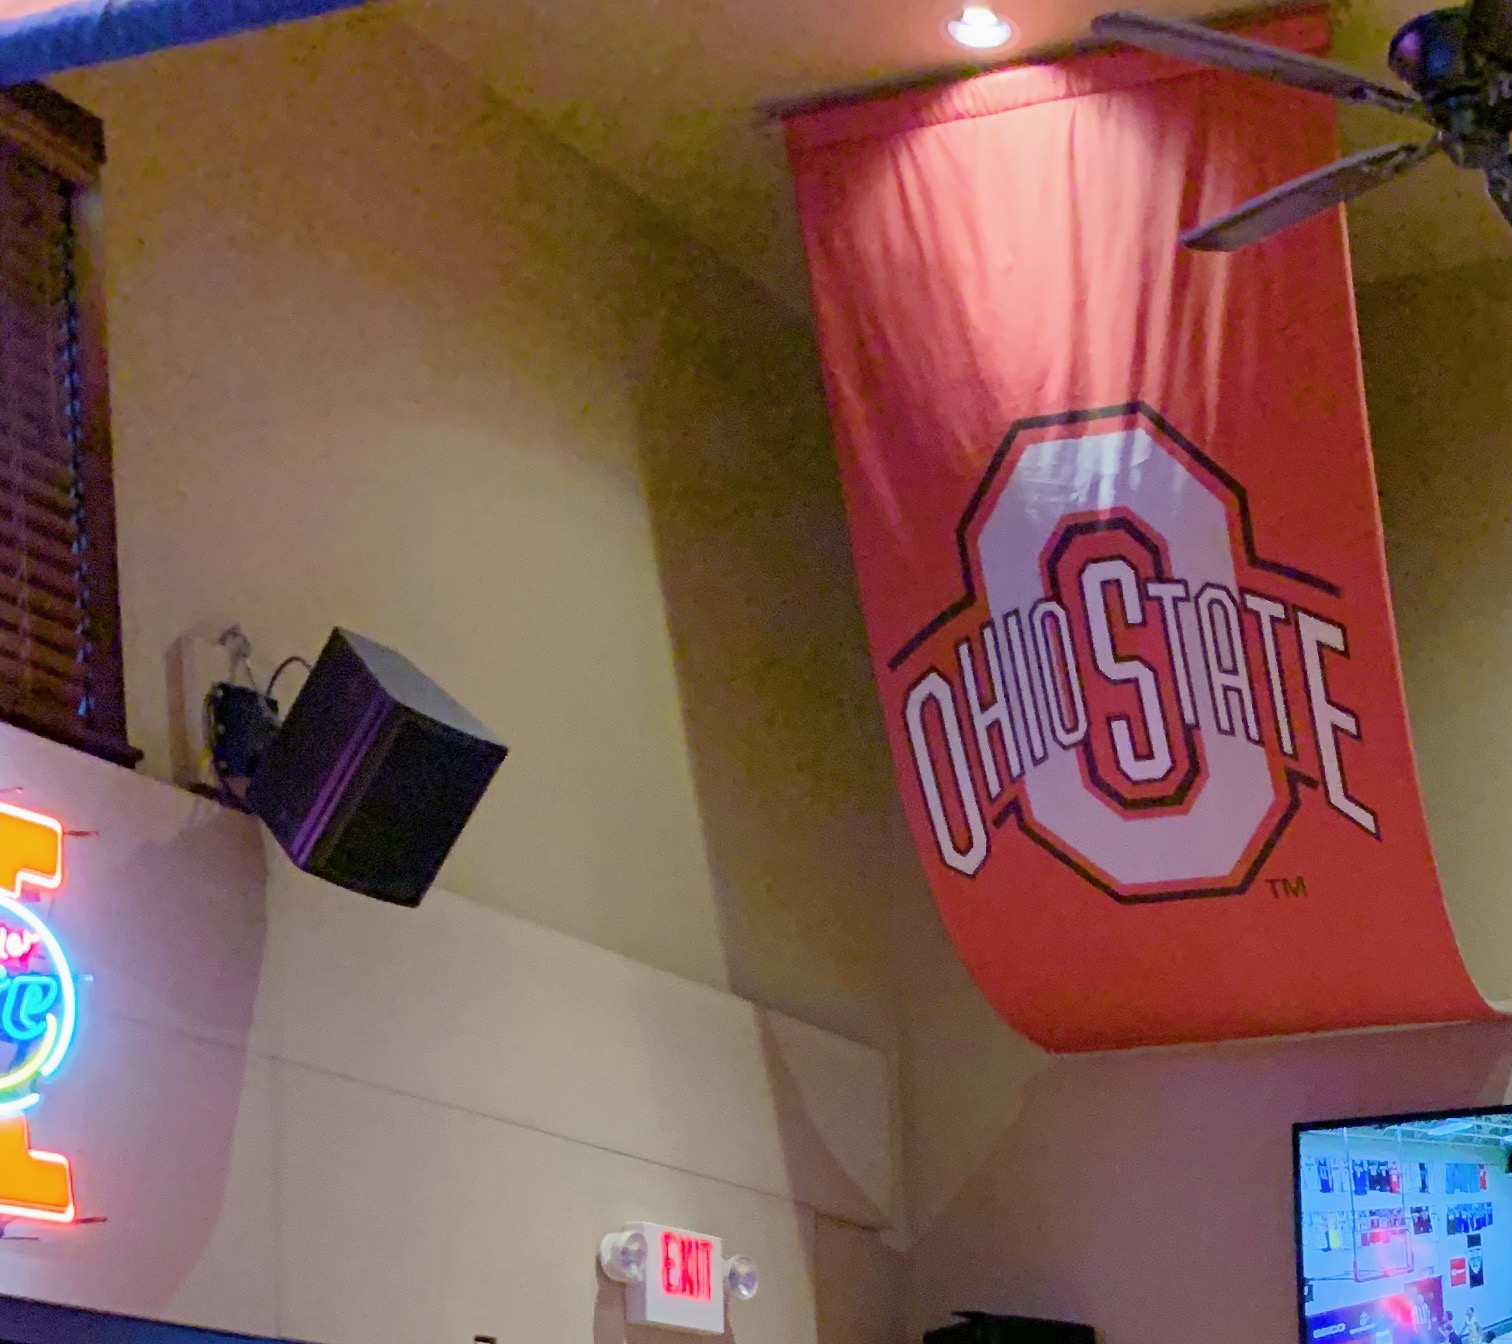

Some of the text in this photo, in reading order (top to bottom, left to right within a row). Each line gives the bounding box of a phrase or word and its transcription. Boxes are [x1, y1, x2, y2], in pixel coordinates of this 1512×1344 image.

[902, 555, 1382, 878] OHIO STATE
[660, 1231, 715, 1303] EXIT
